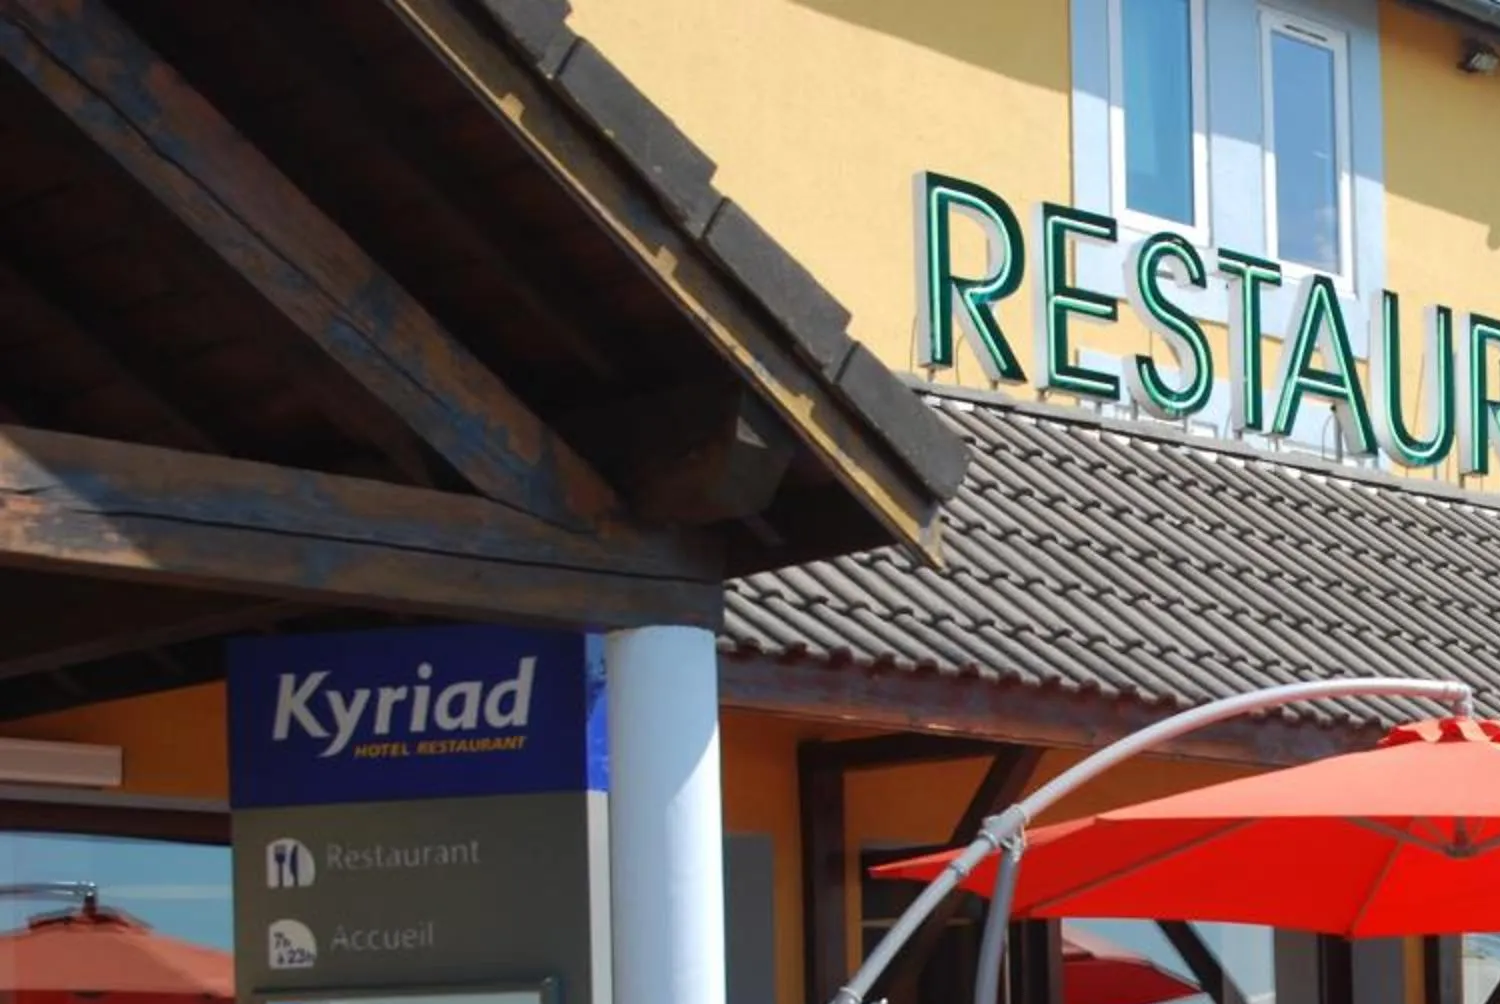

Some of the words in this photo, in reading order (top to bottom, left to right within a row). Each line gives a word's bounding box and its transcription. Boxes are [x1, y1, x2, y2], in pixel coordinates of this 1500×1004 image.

[272, 656, 538, 758] Kyriad
[354, 740, 410, 758] HOTEL
[415, 735, 526, 756] RESTAURANT
[327, 840, 480, 869] Restaurant
[330, 919, 435, 952] Accueil
